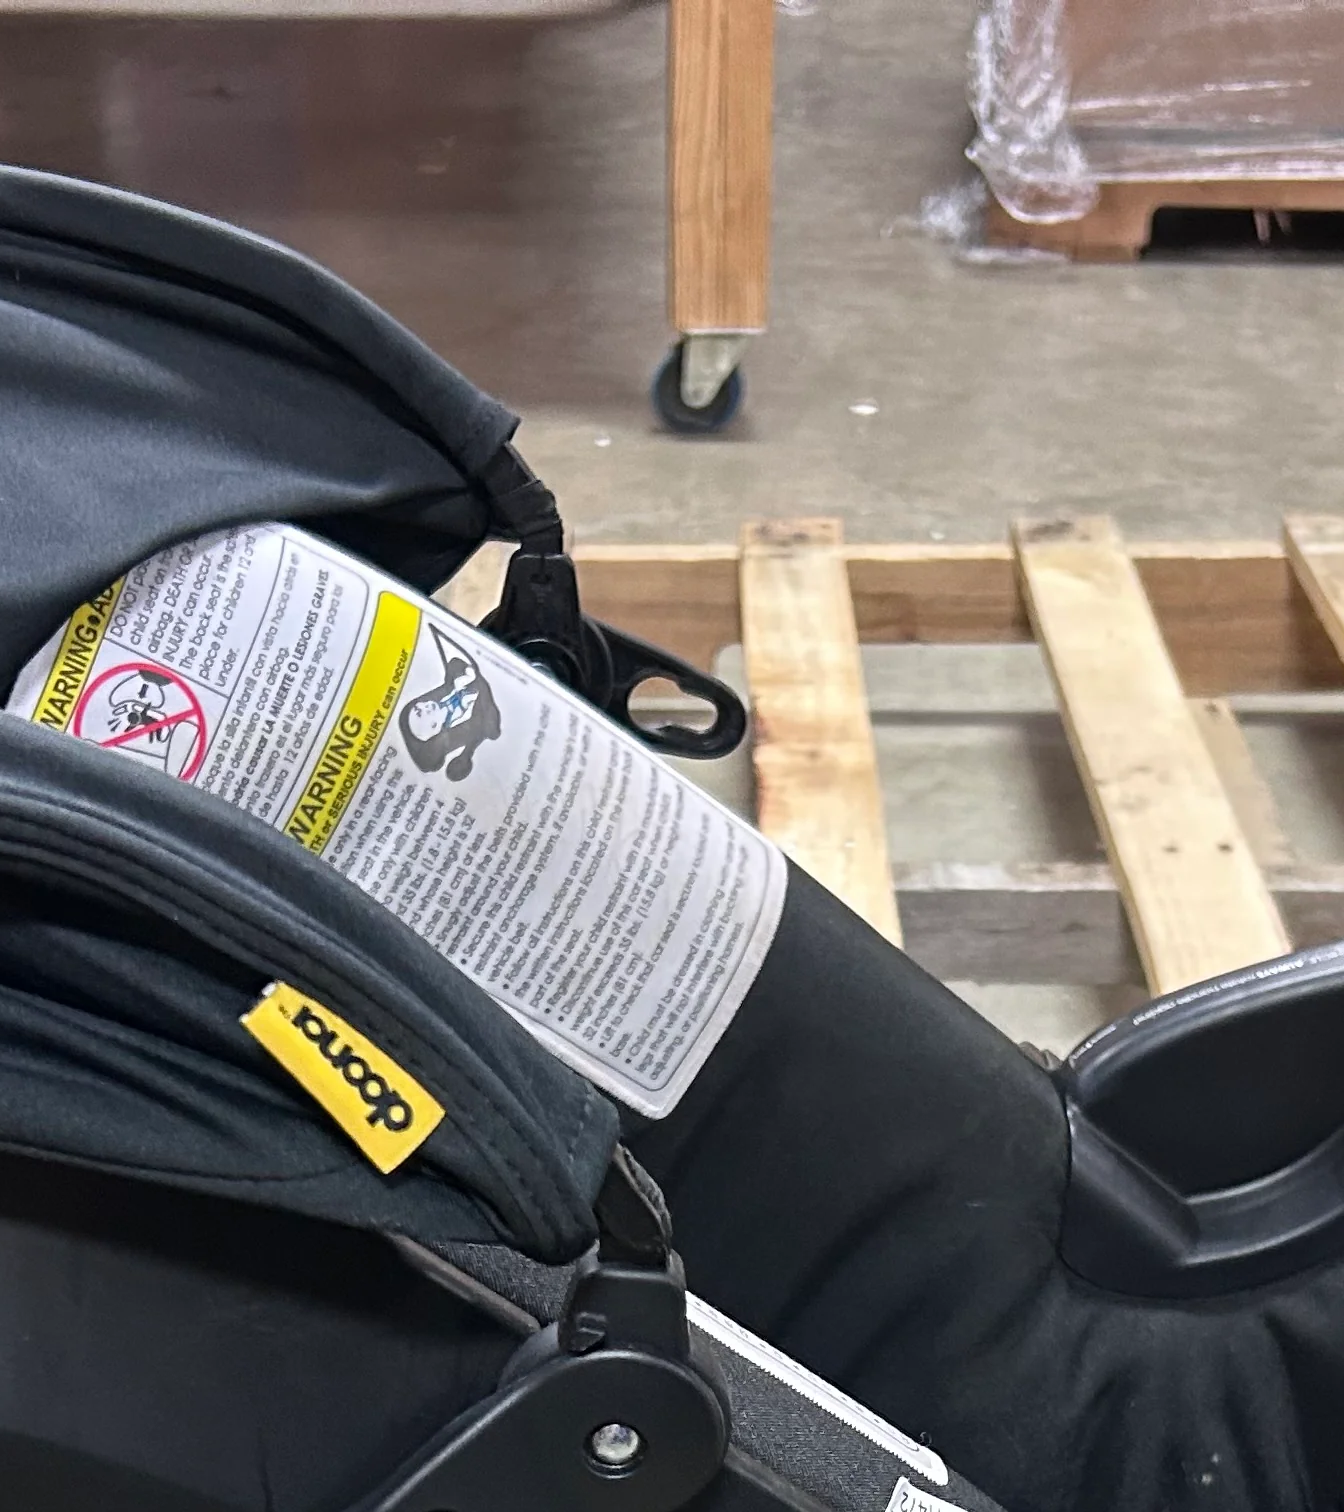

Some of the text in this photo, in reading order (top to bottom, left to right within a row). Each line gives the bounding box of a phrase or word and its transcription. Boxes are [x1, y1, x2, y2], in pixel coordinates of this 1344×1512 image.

[108, 612, 128, 638] DO
[118, 584, 139, 615] NOT
[162, 564, 189, 608] DEATH
[178, 646, 198, 670] The
[188, 612, 212, 646] back
[204, 583, 222, 612] seat
[216, 554, 232, 572] the
[128, 612, 150, 646] child
[140, 584, 162, 614] seat
[162, 616, 190, 662] INJURY
[182, 591, 200, 617] can
[197, 640, 222, 680] place
[212, 620, 228, 640] for
[220, 572, 246, 620] children
[291, 608, 320, 660] LESIONES
[286, 661, 300, 673] O
[255, 686, 272, 711] con
[268, 673, 294, 718] MUERTE
[261, 718, 276, 734] LA
[322, 648, 410, 834] or SERIOUS INJURY can occur
[291, 1006, 414, 1133] doona
